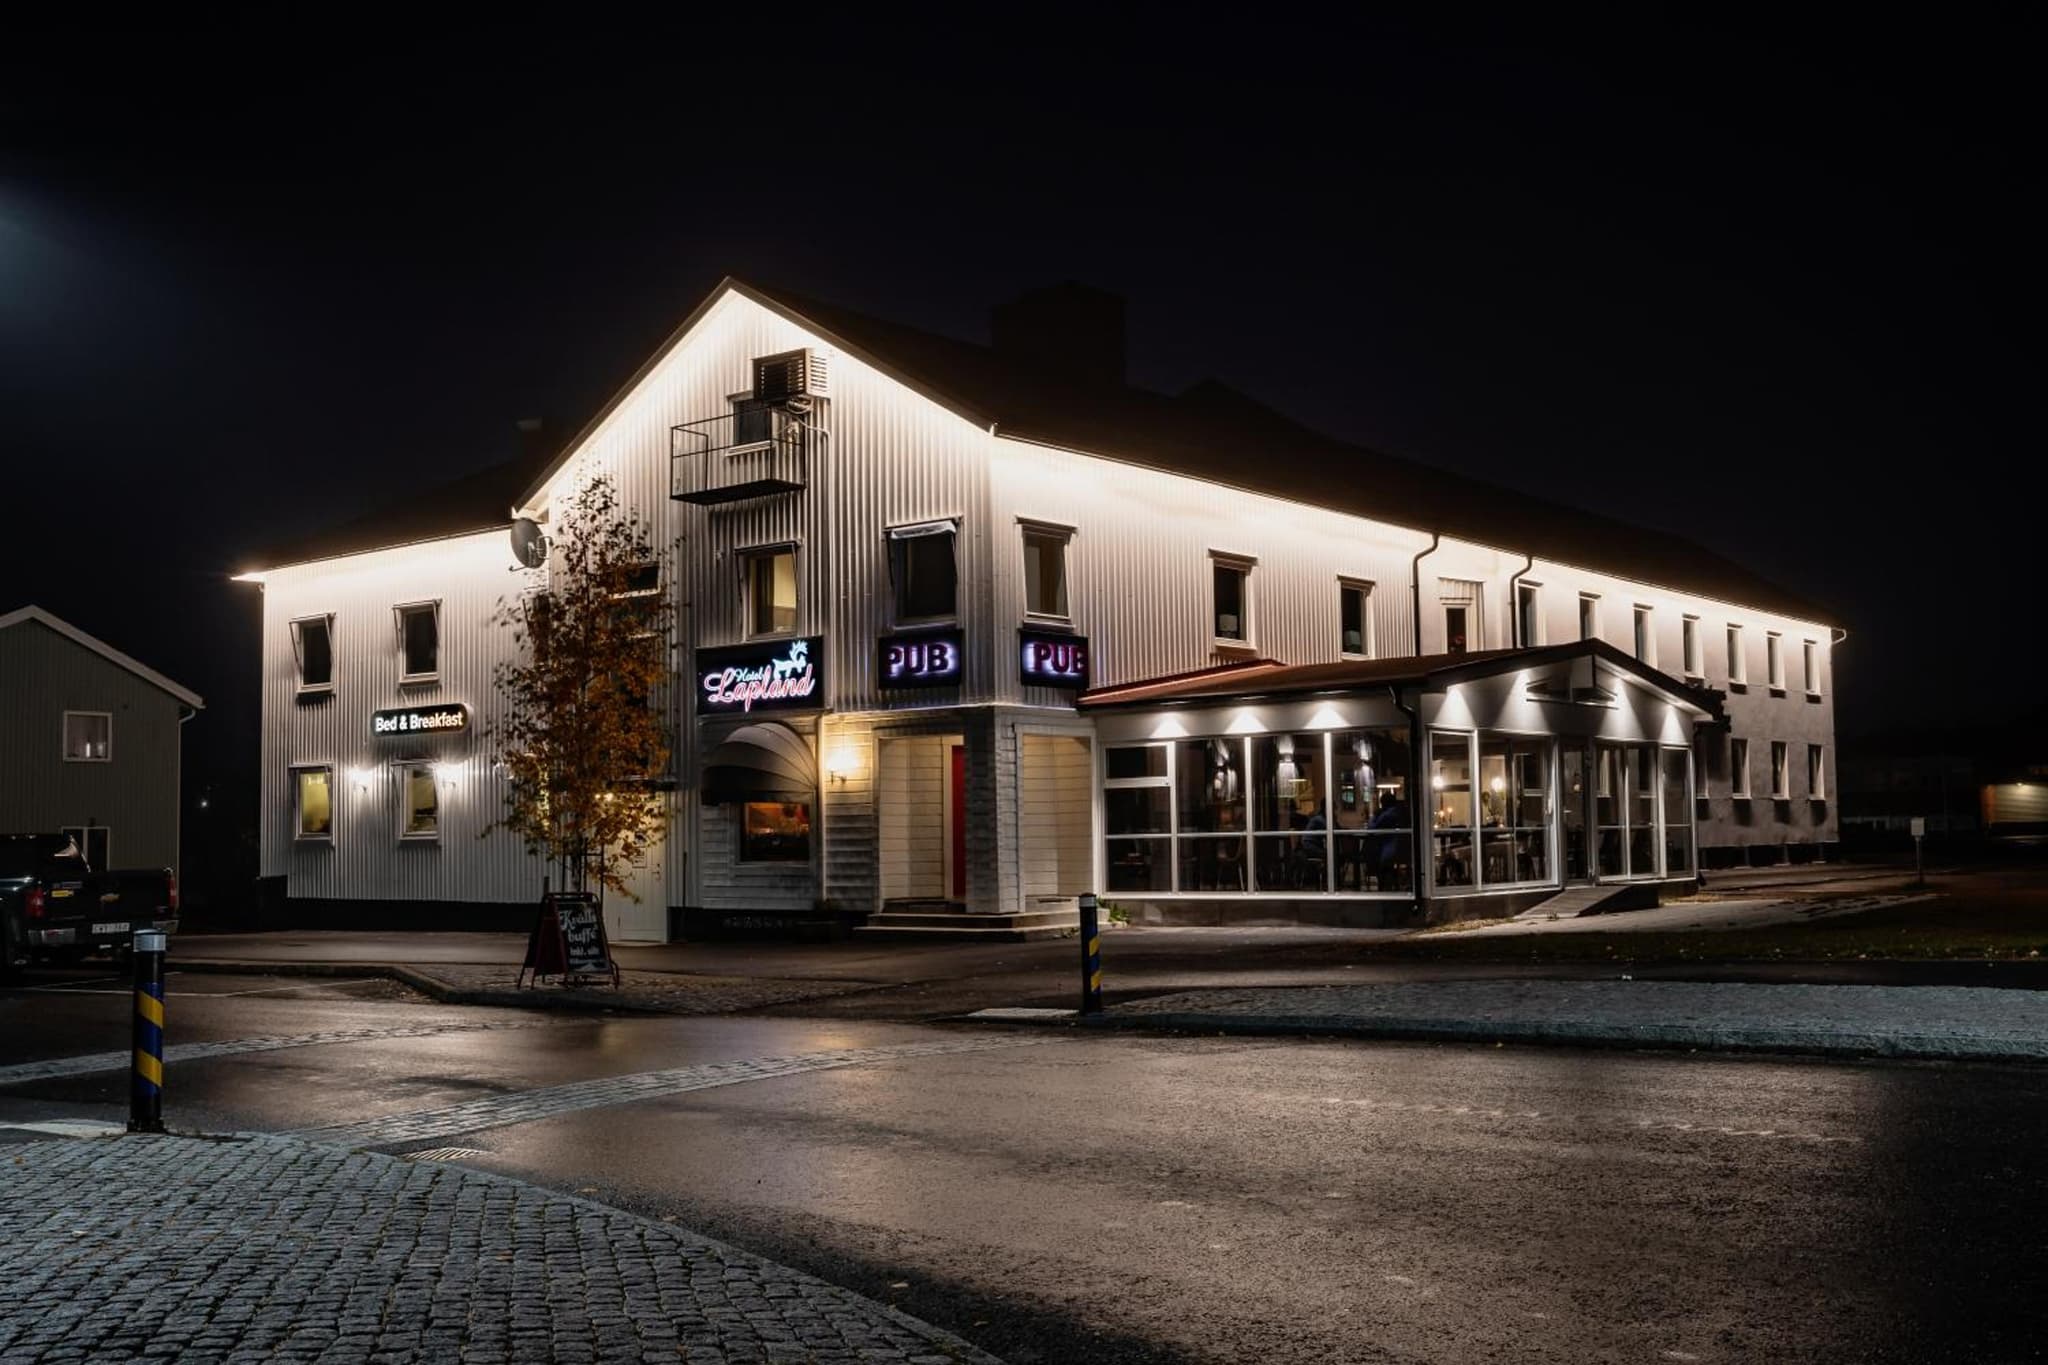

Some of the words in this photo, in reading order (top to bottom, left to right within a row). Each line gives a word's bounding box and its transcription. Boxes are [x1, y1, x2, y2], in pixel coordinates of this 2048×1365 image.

[884, 642, 952, 676] PUB
[704, 664, 815, 712] Lapland
[735, 667, 765, 682] Hotel
[375, 716, 397, 732] Bed
[400, 714, 408, 730] &
[410, 712, 463, 730] Breakfast
